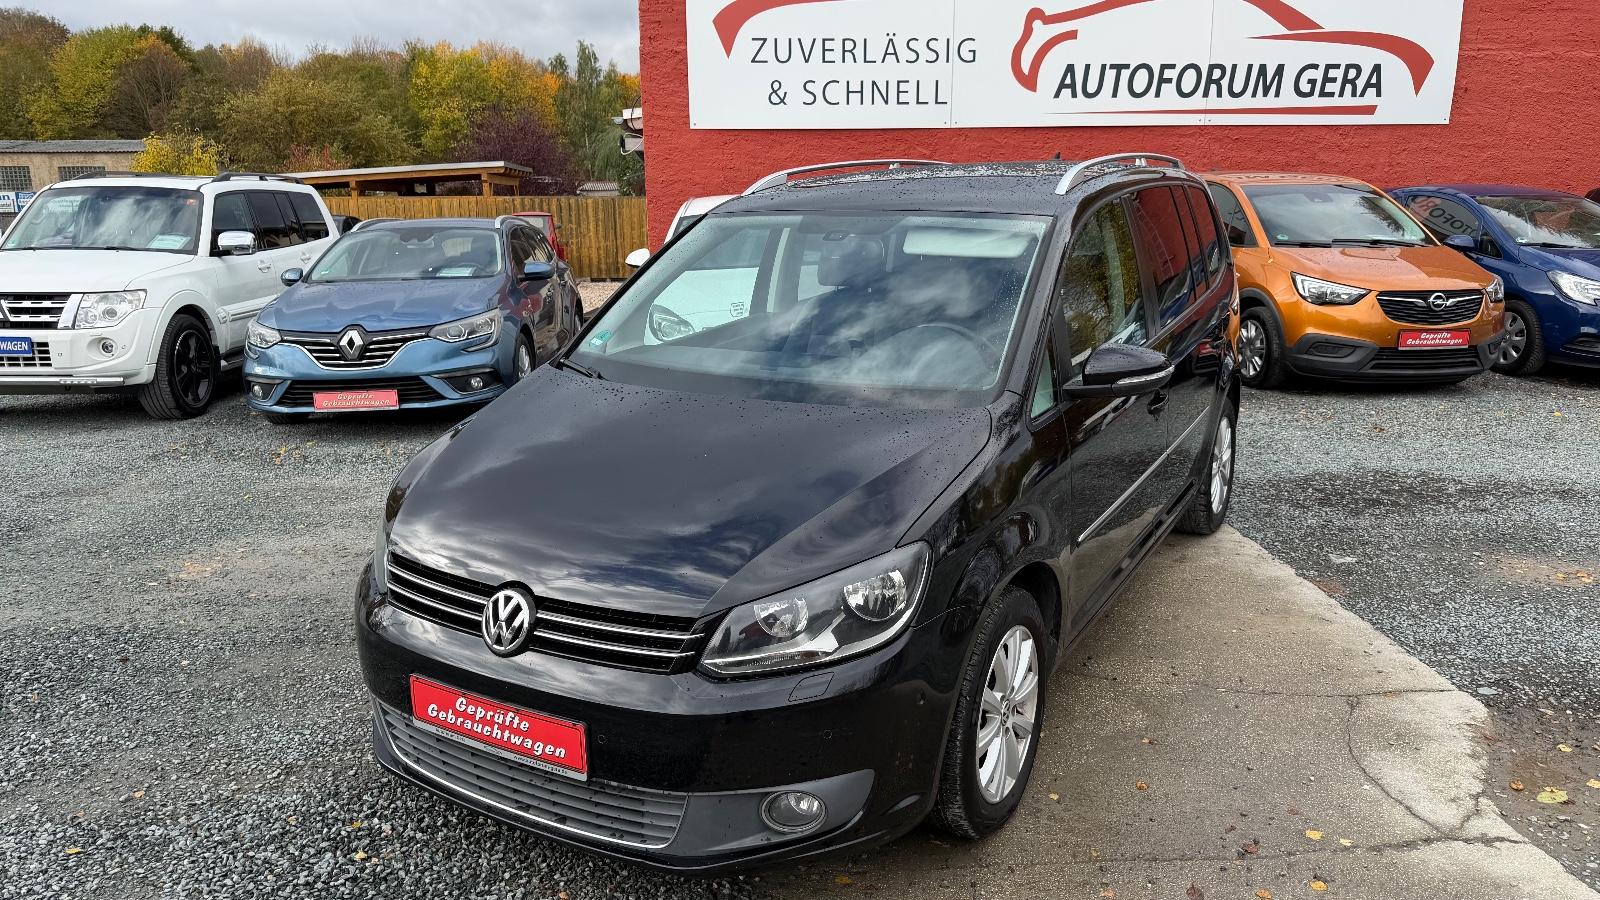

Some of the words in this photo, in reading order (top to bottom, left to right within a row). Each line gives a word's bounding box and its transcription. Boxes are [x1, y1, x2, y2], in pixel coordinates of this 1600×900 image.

[750, 32, 977, 64] ZUVERLÄSSIG
[768, 79, 788, 106] &
[802, 79, 948, 106] SCHNELL
[1053, 62, 1285, 99] AUTOFORUM
[1293, 62, 1382, 99] GERA
[484, 590, 528, 649] VW
[427, 703, 566, 759] Gebrauchtwagen
[455, 696, 530, 732] Geprüfte
